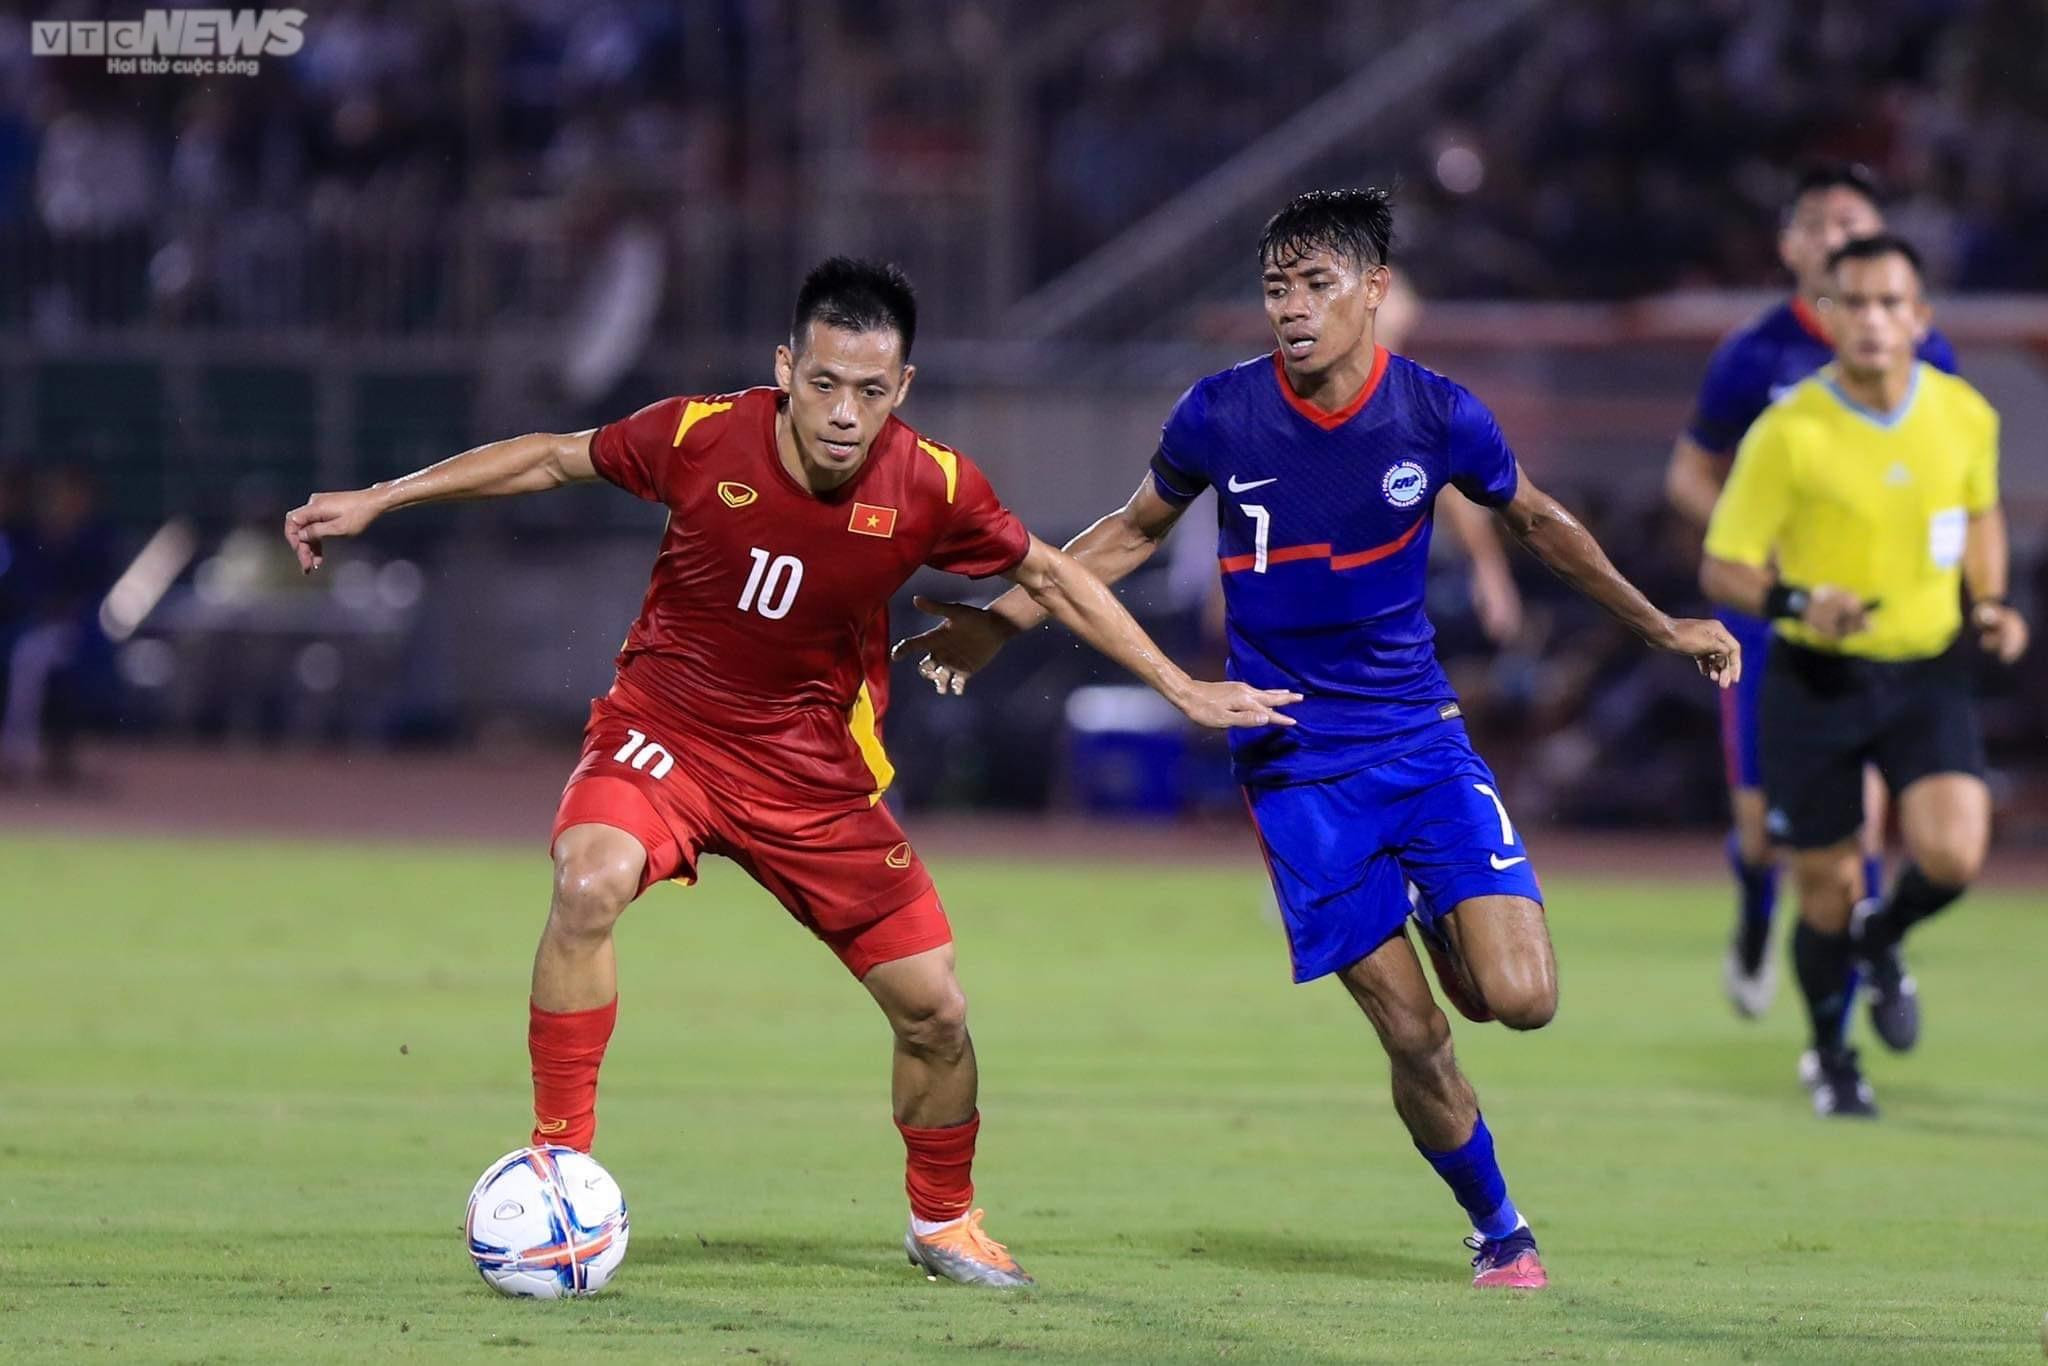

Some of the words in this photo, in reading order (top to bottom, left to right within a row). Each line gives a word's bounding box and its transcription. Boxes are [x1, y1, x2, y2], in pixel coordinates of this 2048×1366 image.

[1239, 503, 1270, 574] 7
[737, 547, 804, 620] 10
[613, 728, 675, 780] 10
[1473, 783, 1515, 846] 7
